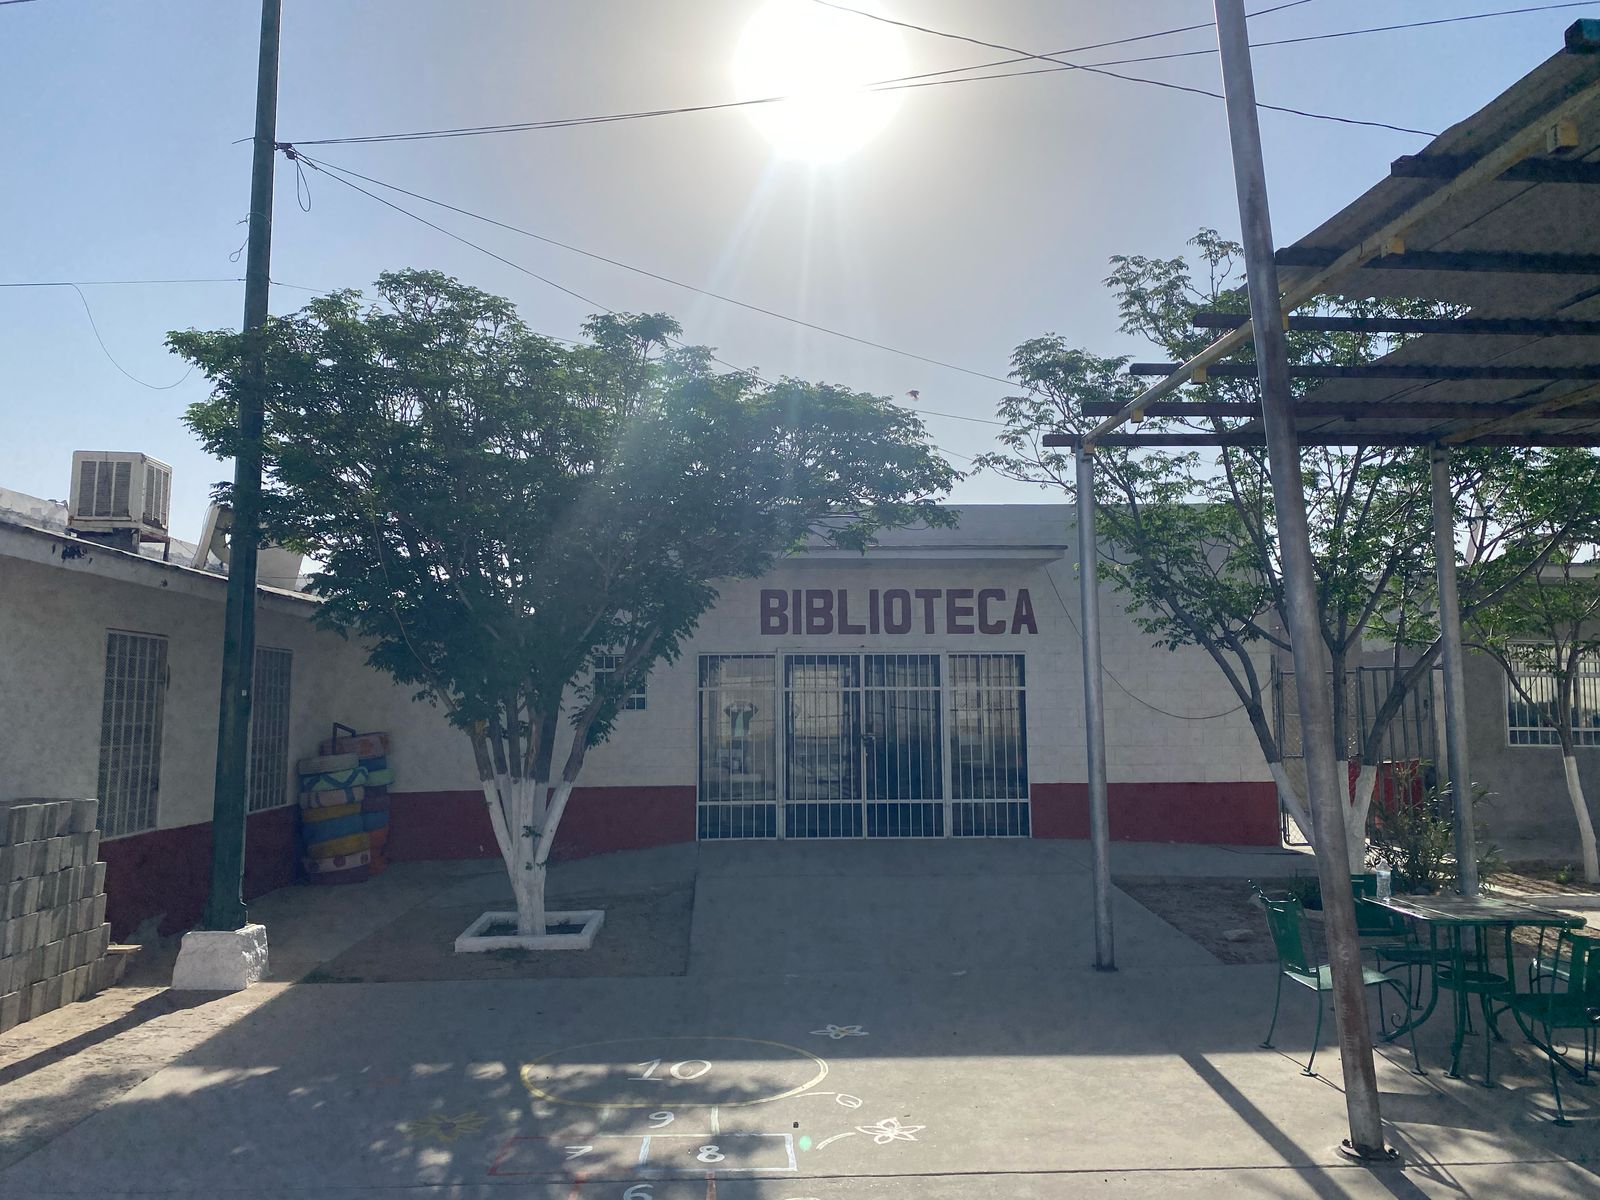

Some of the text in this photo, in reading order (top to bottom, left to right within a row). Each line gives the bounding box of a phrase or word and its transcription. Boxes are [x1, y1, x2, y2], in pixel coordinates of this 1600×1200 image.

[760, 588, 1038, 635] BIBLIOTECA
[627, 1058, 713, 1081] 10
[648, 1111, 675, 1129] 9
[564, 1145, 594, 1161] 7
[696, 1145, 726, 1163] 8
